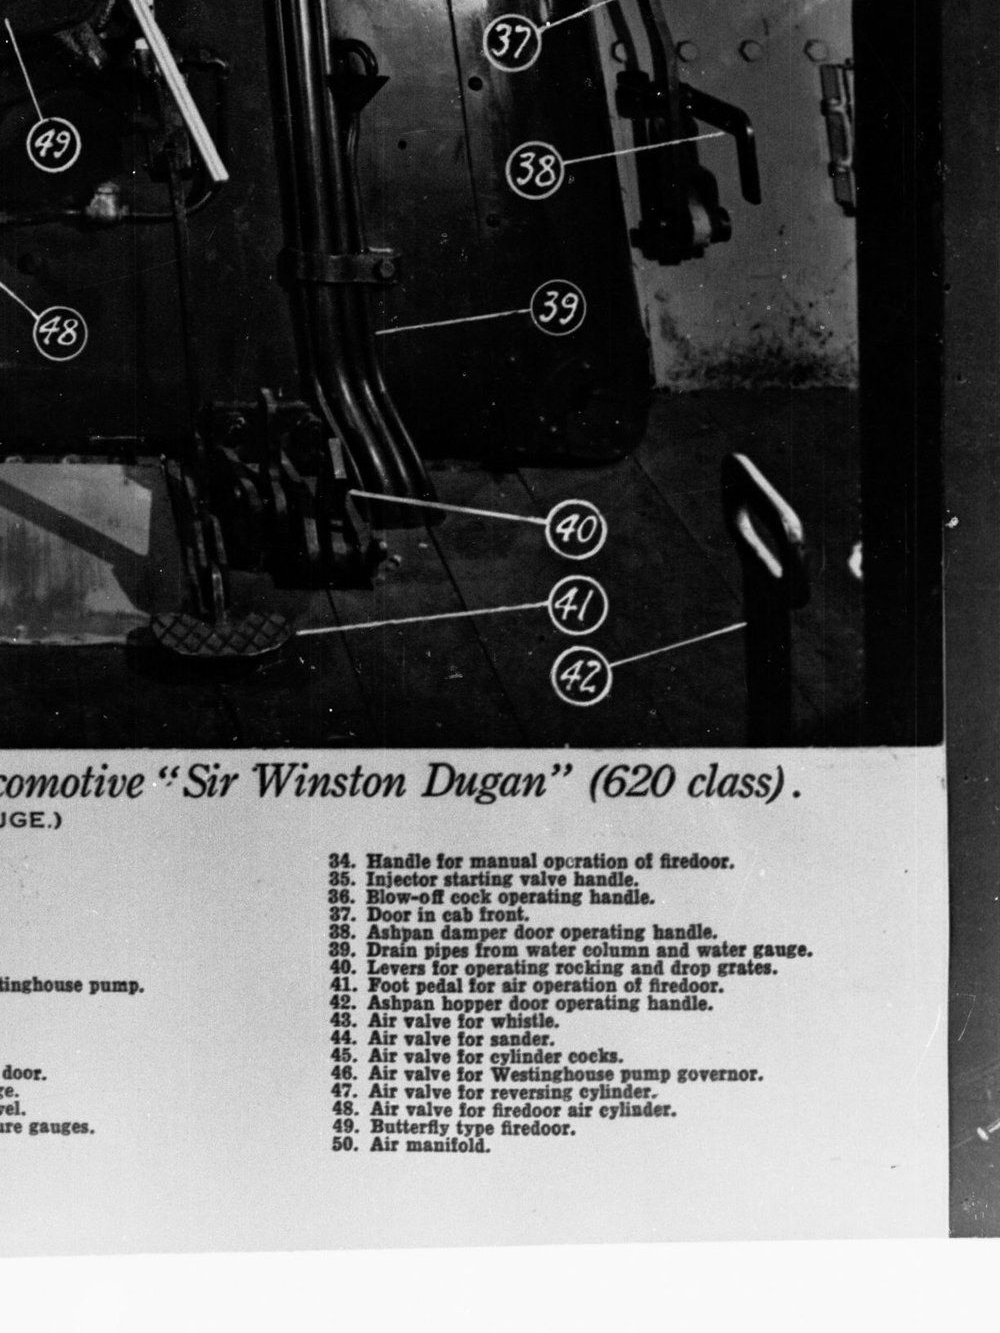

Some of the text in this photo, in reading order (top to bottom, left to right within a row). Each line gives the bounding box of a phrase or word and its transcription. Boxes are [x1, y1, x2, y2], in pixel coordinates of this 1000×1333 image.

[251, 761, 407, 799] Winston
[588, 763, 677, 804] (620
[327, 890, 656, 907] 36. Blow-off cock operating handle.
[327, 942, 814, 960] 39. Drain pipes from water column and water gauge.
[329, 960, 779, 978] 40. Levers for operating rocking and drop grates.
[88, 981, 145, 995] pump.
[1, 1066, 48, 1080] door.
[330, 1066, 764, 1084] 46. Air valve for Westinghouse pump governor.
[28, 1122, 96, 1136] gauges.
